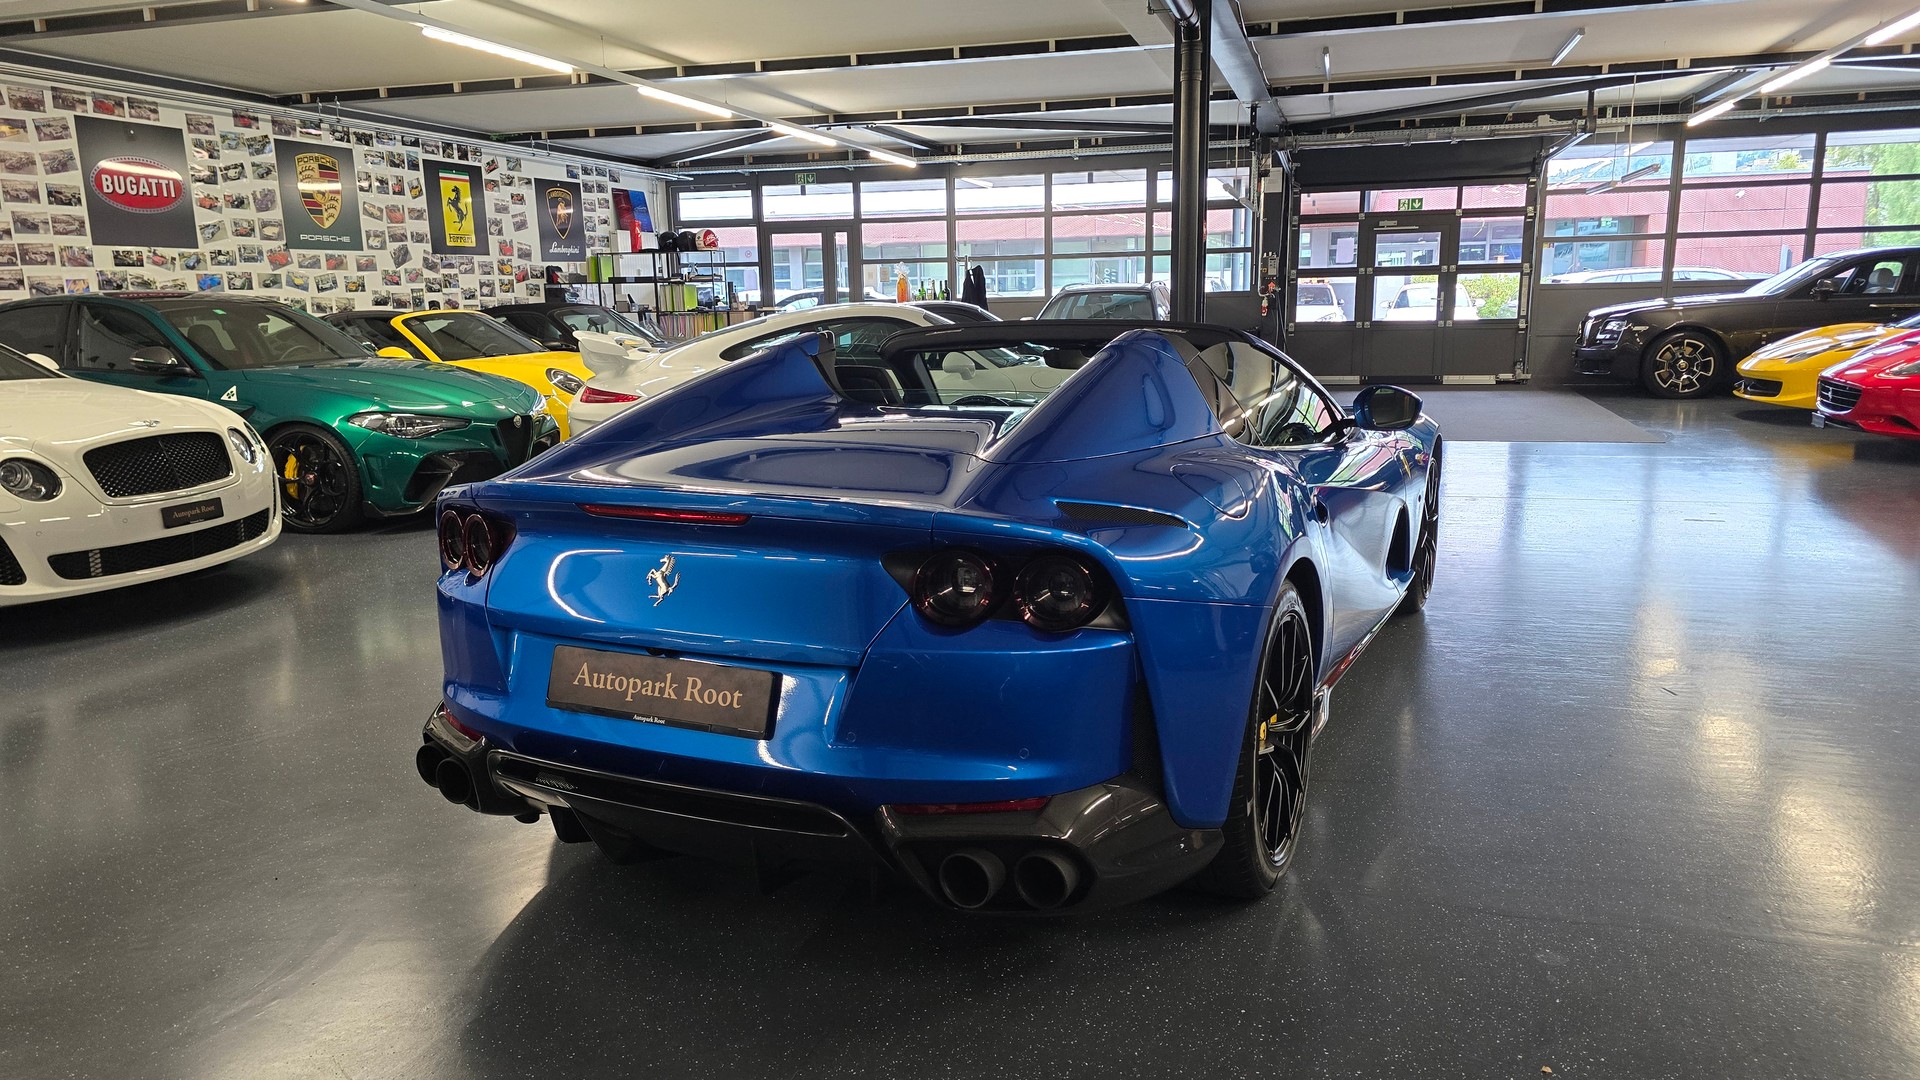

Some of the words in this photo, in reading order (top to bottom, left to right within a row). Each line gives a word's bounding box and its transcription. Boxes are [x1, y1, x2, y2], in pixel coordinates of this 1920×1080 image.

[297, 155, 338, 168] PORSCHE
[101, 174, 176, 199] BUGATTI
[300, 234, 351, 243] PORSCHE
[448, 233, 474, 244] Ferrari
[549, 241, 580, 256] Lamborghini
[173, 507, 201, 518] Autopark
[573, 662, 679, 701] Autopark
[684, 676, 743, 709] Root
[632, 714, 653, 723] Autopark
[653, 716, 666, 724] Root
